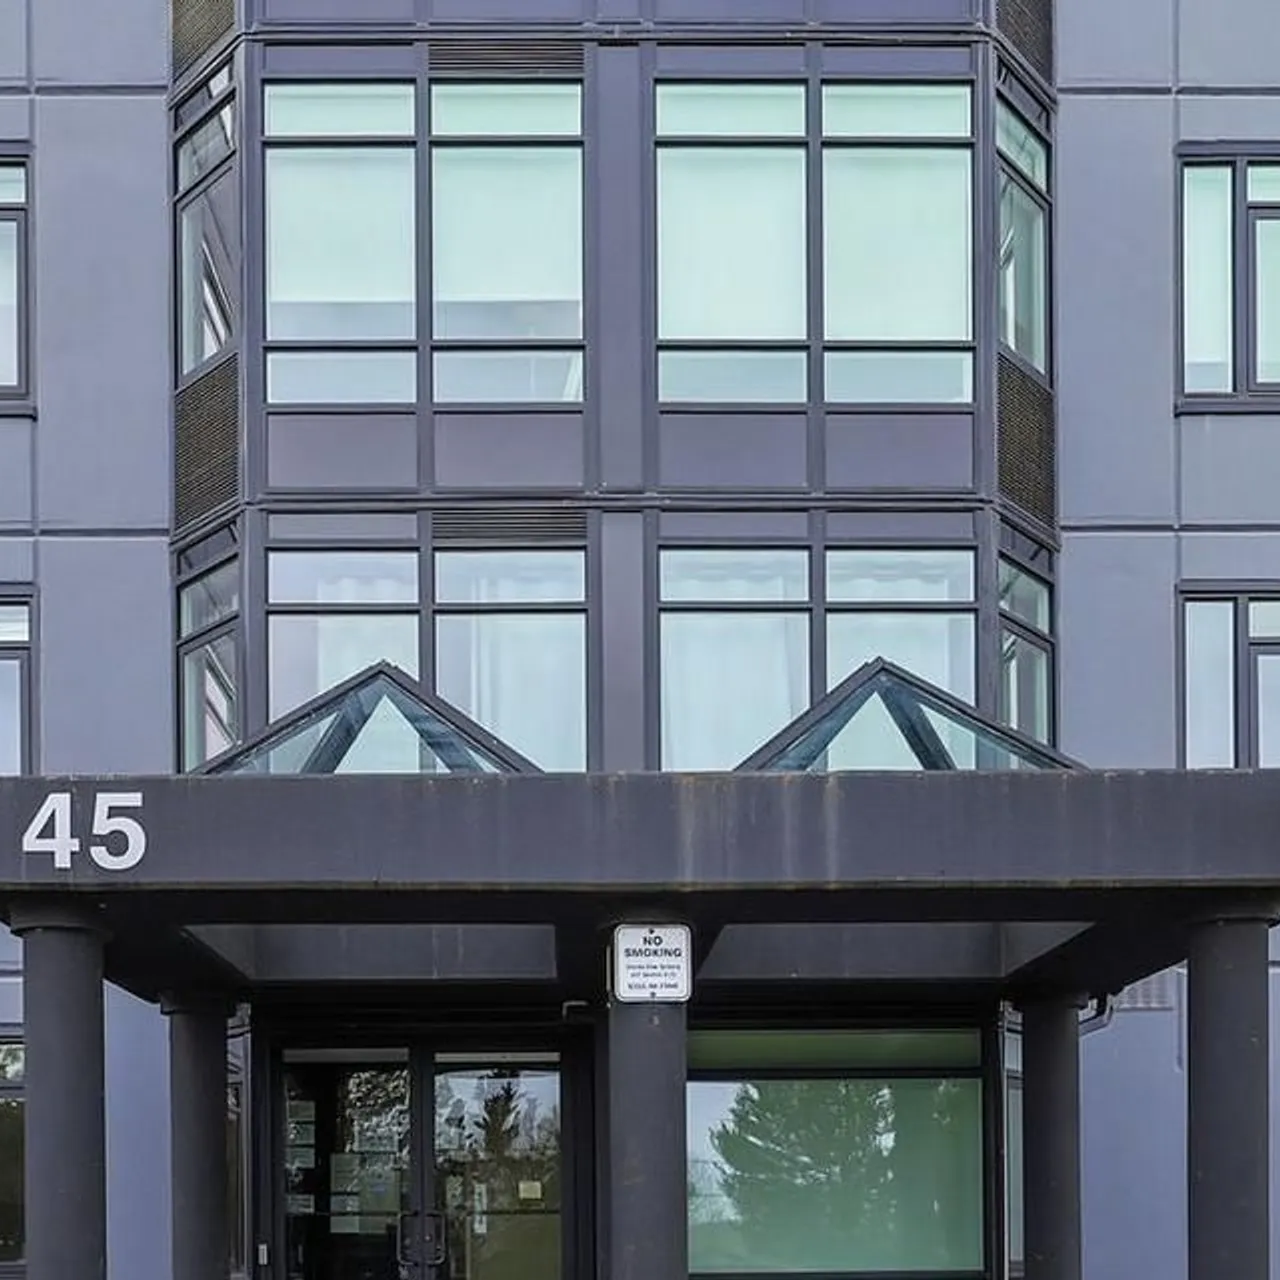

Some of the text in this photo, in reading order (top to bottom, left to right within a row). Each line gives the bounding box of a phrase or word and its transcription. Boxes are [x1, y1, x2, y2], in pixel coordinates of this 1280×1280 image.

[21, 792, 146, 869] 45
[643, 936, 663, 946] NO
[624, 948, 682, 958] SMOKING
